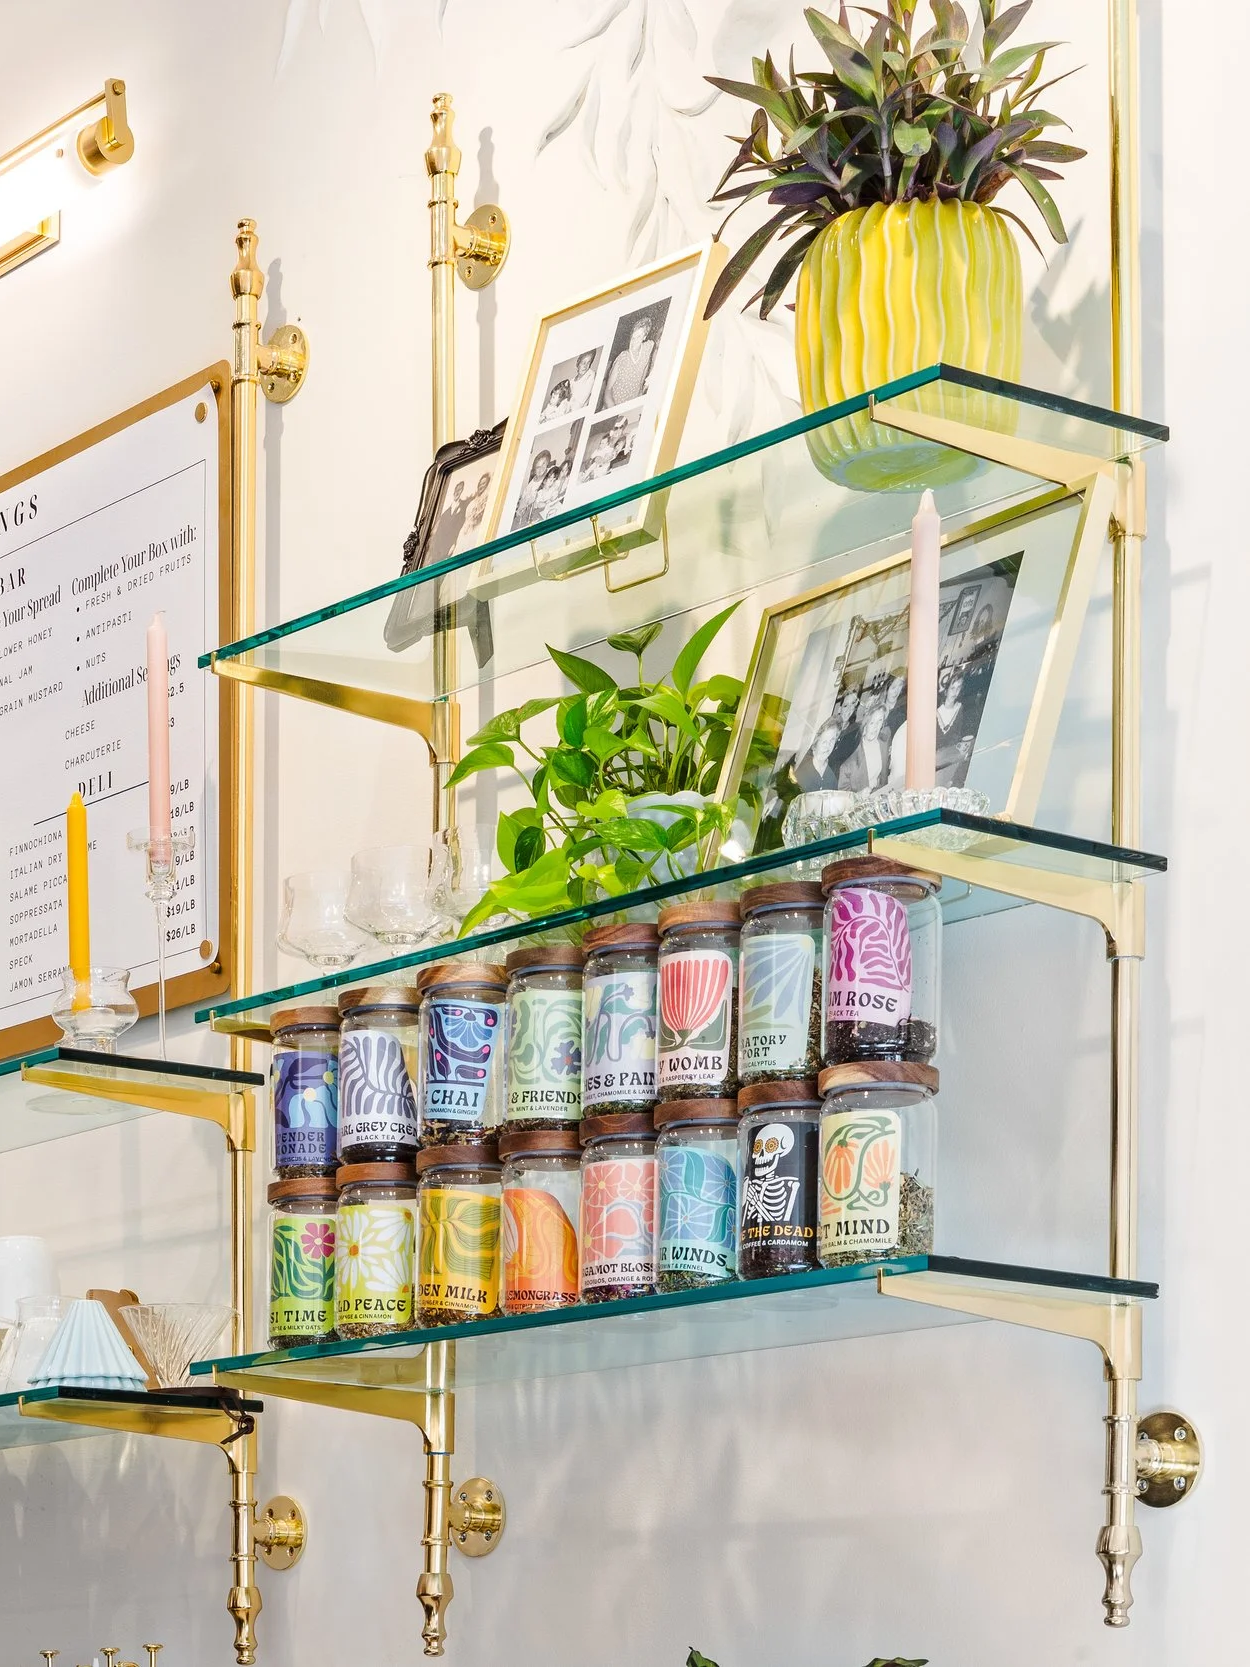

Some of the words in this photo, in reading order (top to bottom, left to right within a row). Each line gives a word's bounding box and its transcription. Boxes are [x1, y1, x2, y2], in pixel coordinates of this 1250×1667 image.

[71, 562, 119, 596] Complete
[120, 550, 146, 574] Your
[148, 540, 168, 562] Box
[170, 524, 197, 551] with:
[85, 590, 112, 610] FRESH
[116, 585, 122, 596] &
[127, 570, 154, 592] DRIED
[159, 553, 192, 577] FRUITS
[2, 606, 26, 628] Your
[27, 584, 62, 620] Spread
[86, 610, 132, 640] ANTIPASTI
[28, 626, 53, 646] HONEY
[86, 652, 106, 670] NUTS
[18, 664, 34, 680] JAM
[28, 680, 63, 704] MUSTARD
[81, 668, 134, 708] Additional
[64, 720, 96, 740] CHEESE
[64, 739, 122, 770] CHARCUTERIE
[78, 770, 112, 799] DELI
[10, 830, 62, 856] FINNOCHIONA
[170, 778, 190, 796] 9/LB
[10, 860, 43, 880] ITALIAN
[48, 852, 62, 866] DRY
[170, 802, 194, 818] 18/LB
[175, 850, 195, 866] 9/LB
[10, 884, 38, 902] SALAME
[43, 874, 68, 890] PICCA
[10, 899, 63, 926] SOPPRESSATA
[10, 923, 58, 948] MORTADELLA
[166, 899, 196, 918] $19/LB
[9, 954, 34, 970] SPECK
[166, 923, 196, 942] $26/LB
[10, 976, 34, 993] JAMON
[846, 990, 898, 1012] ROSE
[742, 1046, 770, 1060] PORT
[668, 1056, 722, 1072] WOMB
[604, 1074, 616, 1088] &
[431, 1089, 479, 1108] CHAI
[511, 1092, 519, 1104] &
[596, 1089, 632, 1098] CHAMOMILE
[456, 1108, 478, 1116] GINGER
[356, 1121, 388, 1133] GREY
[276, 1132, 325, 1143] ENDER
[356, 1134, 378, 1142] BLACK
[278, 1143, 327, 1155] ONADE
[748, 1226, 770, 1239] THE
[774, 1224, 814, 1238] DEAD
[835, 1218, 890, 1238] MIND
[767, 1239, 808, 1247] CARDAMOM
[671, 1246, 728, 1268] WINDS
[679, 1263, 704, 1272] FENNEL
[444, 1284, 488, 1304] MILK
[354, 1298, 406, 1312] PEACE
[444, 1300, 478, 1310] CINNAMON
[284, 1310, 328, 1322] TIME
